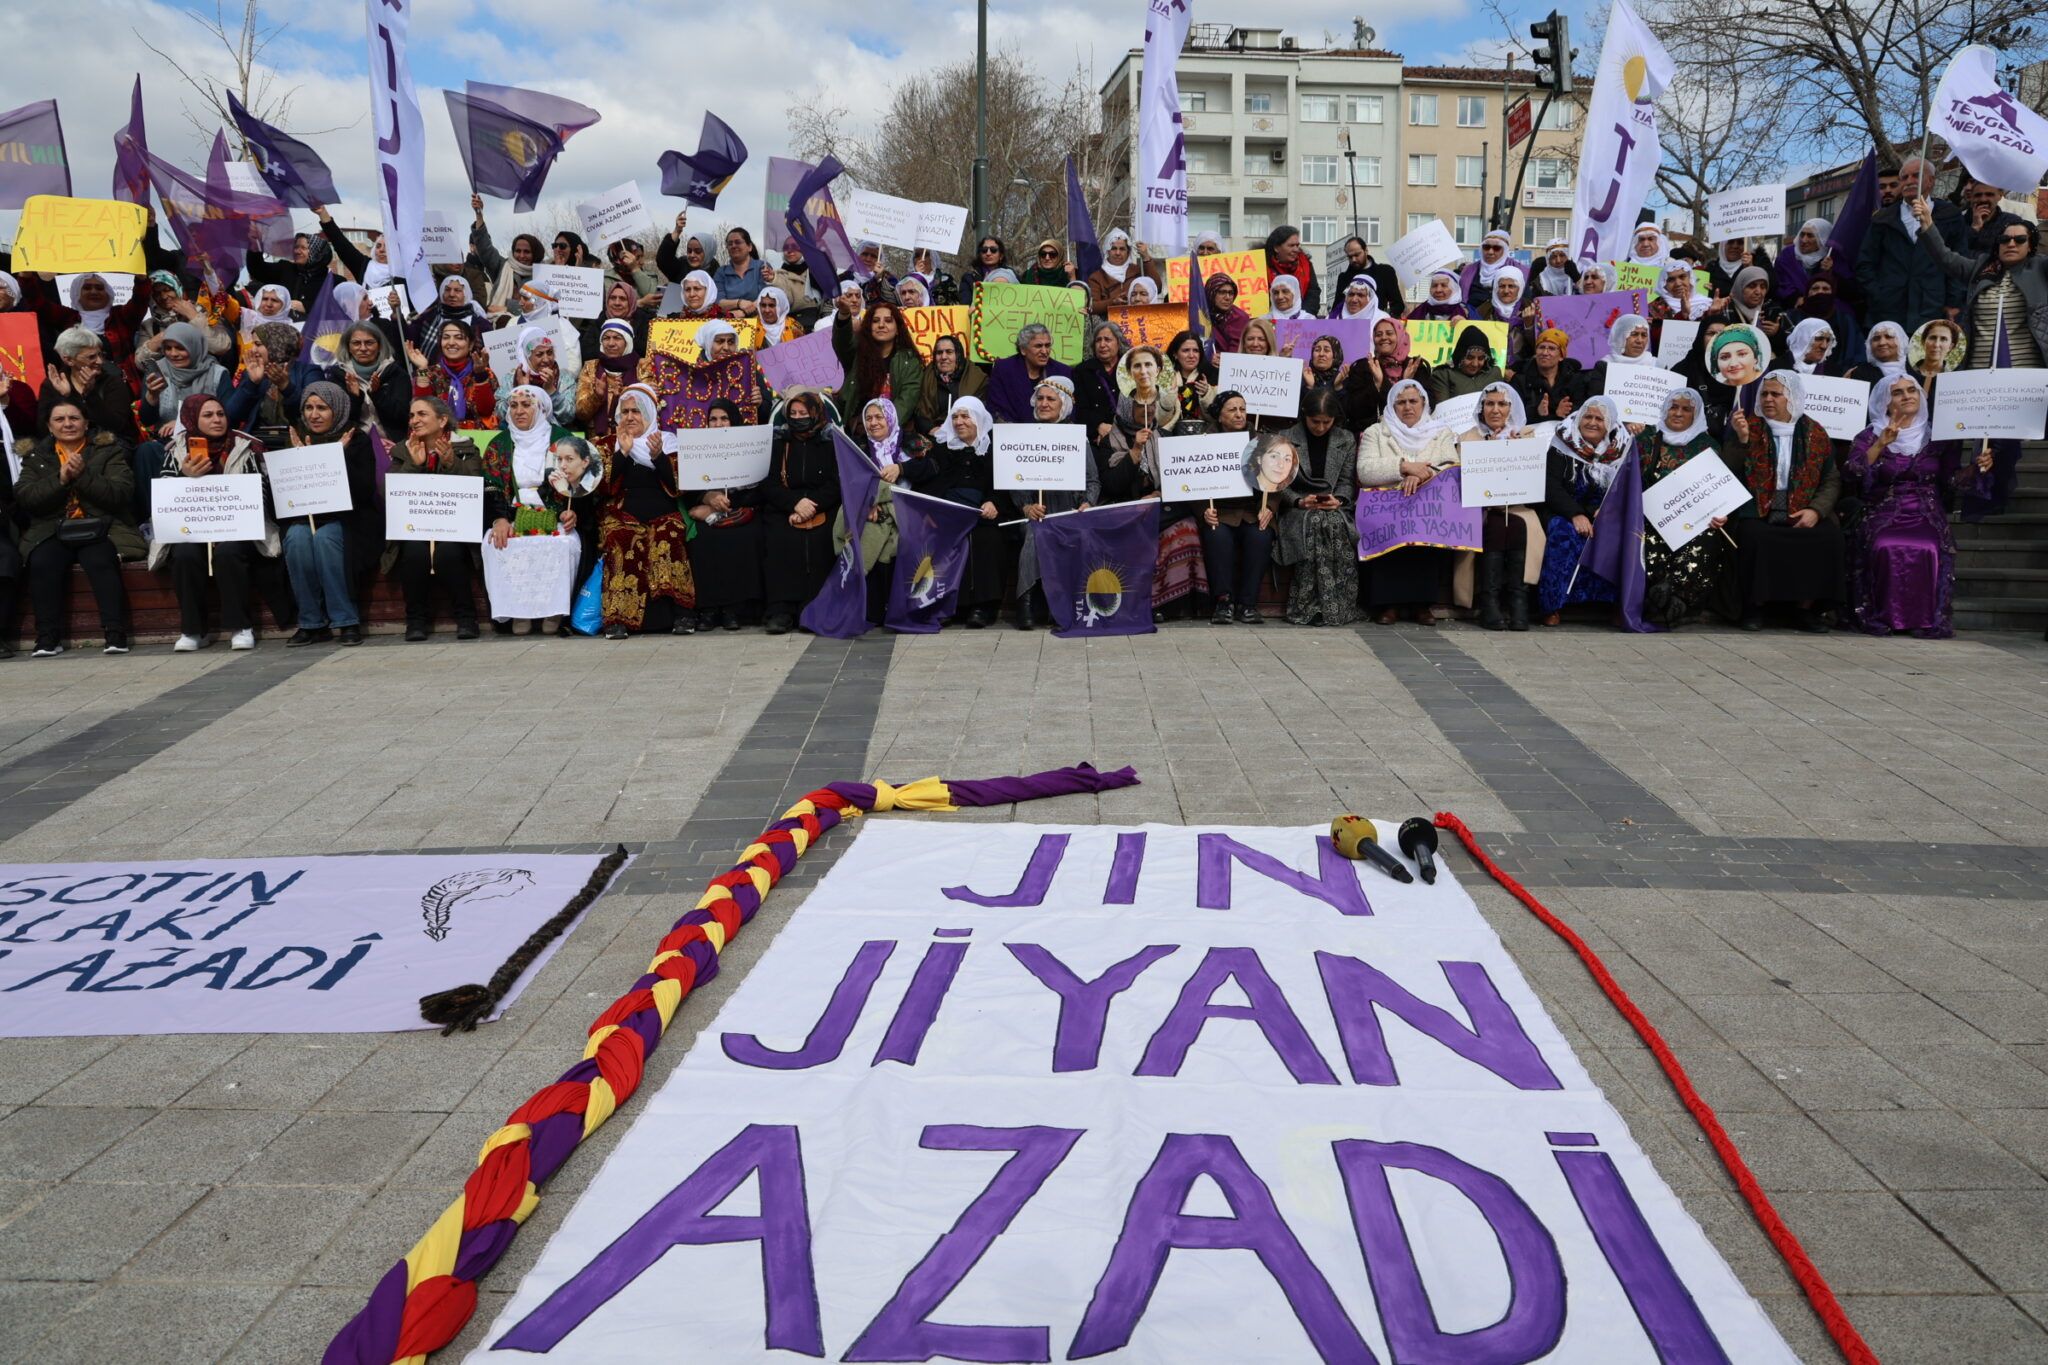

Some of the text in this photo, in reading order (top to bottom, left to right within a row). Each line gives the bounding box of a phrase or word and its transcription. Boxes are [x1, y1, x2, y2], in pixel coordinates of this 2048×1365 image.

[1988, 133, 2035, 155] AZAD
[989, 286, 1075, 312] ROJAVA
[1414, 321, 1454, 344] JIN
[1230, 367, 1248, 379] JIN
[1623, 381, 1672, 394] ÖZGÜRLEŞİYO
[1804, 402, 1846, 414] ZGÜRLEŞ!
[1000, 442, 1081, 453] ÖRGÜTLEN, DİREN,
[1016, 453, 1065, 465] ÖZGÜRLEŞ!
[1171, 451, 1241, 464] JIN AZAD NEBE
[1163, 463, 1242, 476] CIVAK AZAD NAB
[218, 503, 259, 512] TOPLUMU
[941, 831, 1374, 917] JIN
